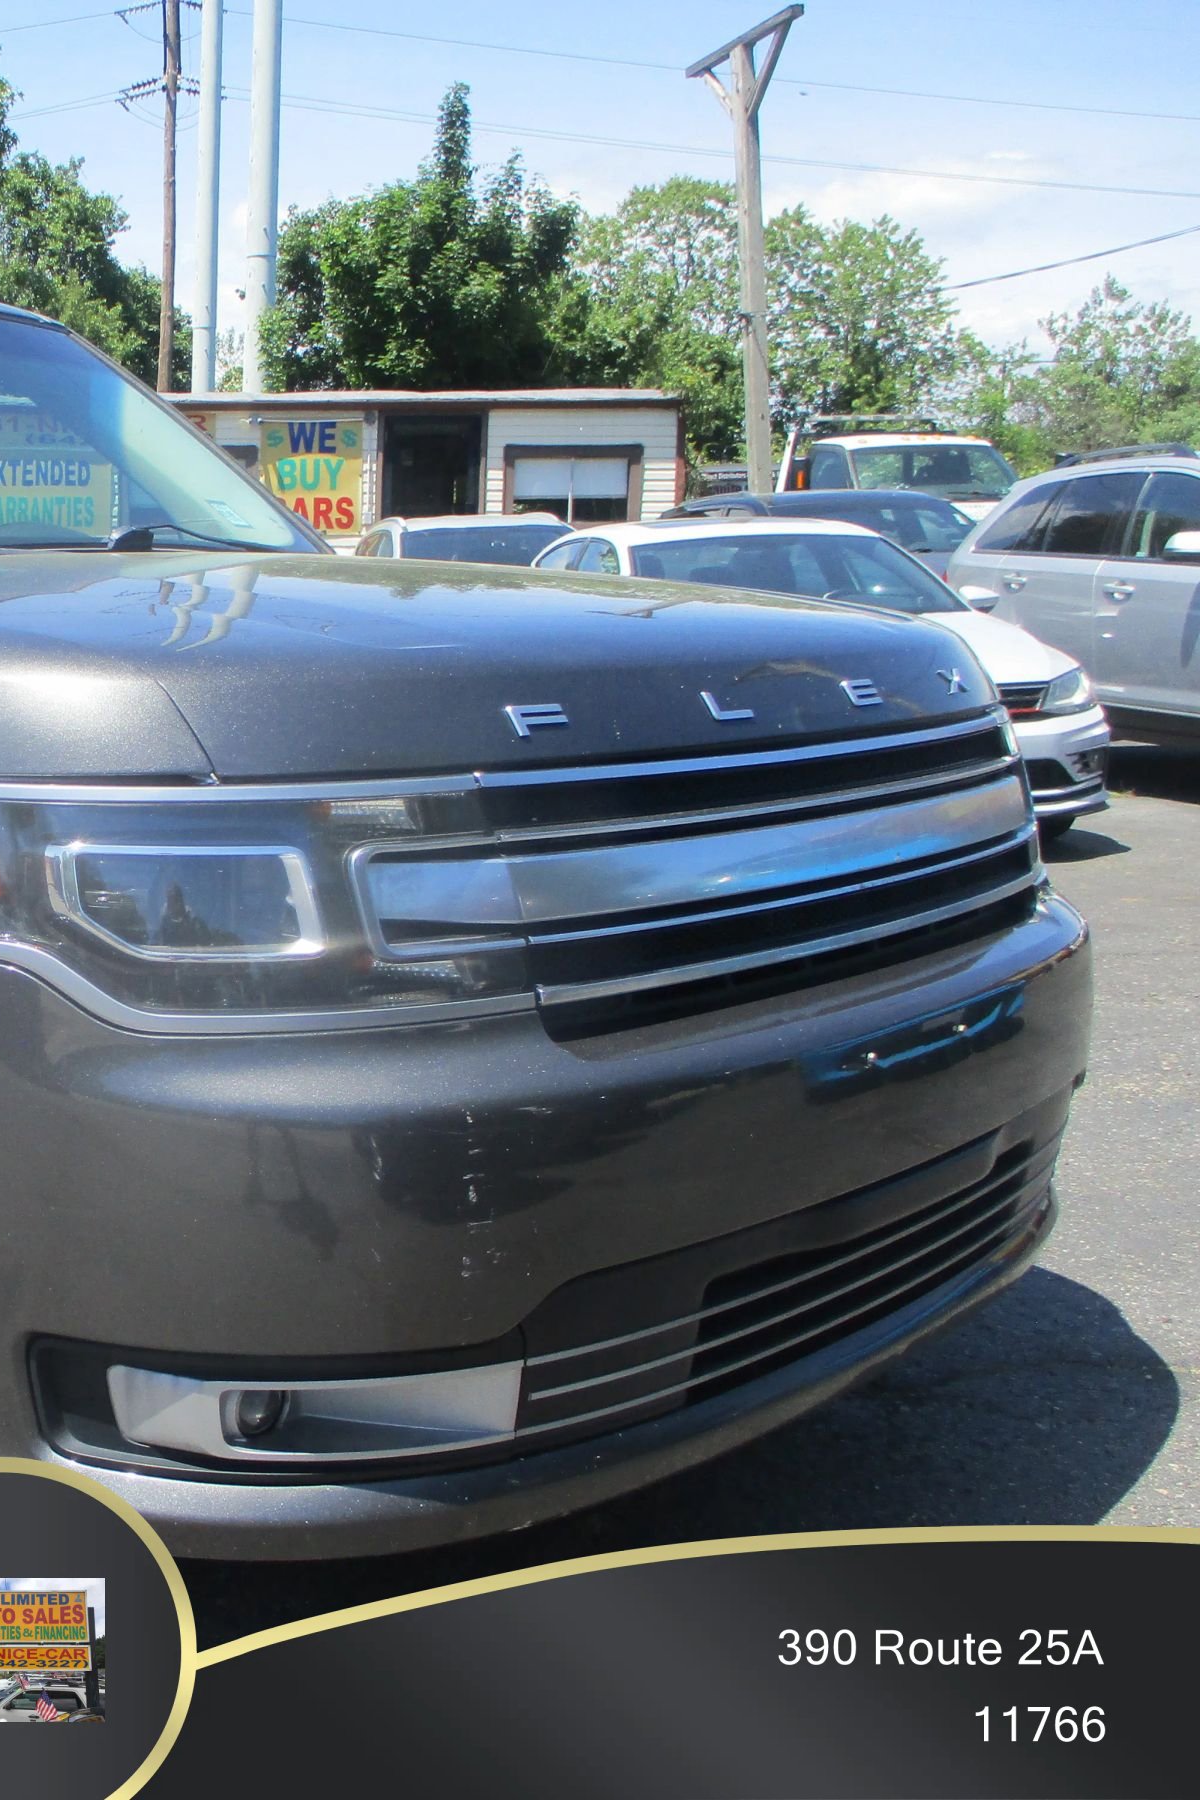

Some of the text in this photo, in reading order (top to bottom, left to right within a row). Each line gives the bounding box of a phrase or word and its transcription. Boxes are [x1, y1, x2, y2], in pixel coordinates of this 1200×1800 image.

[288, 421, 337, 453] WE
[277, 458, 344, 491] BUY
[505, 668, 970, 737] FLEX
